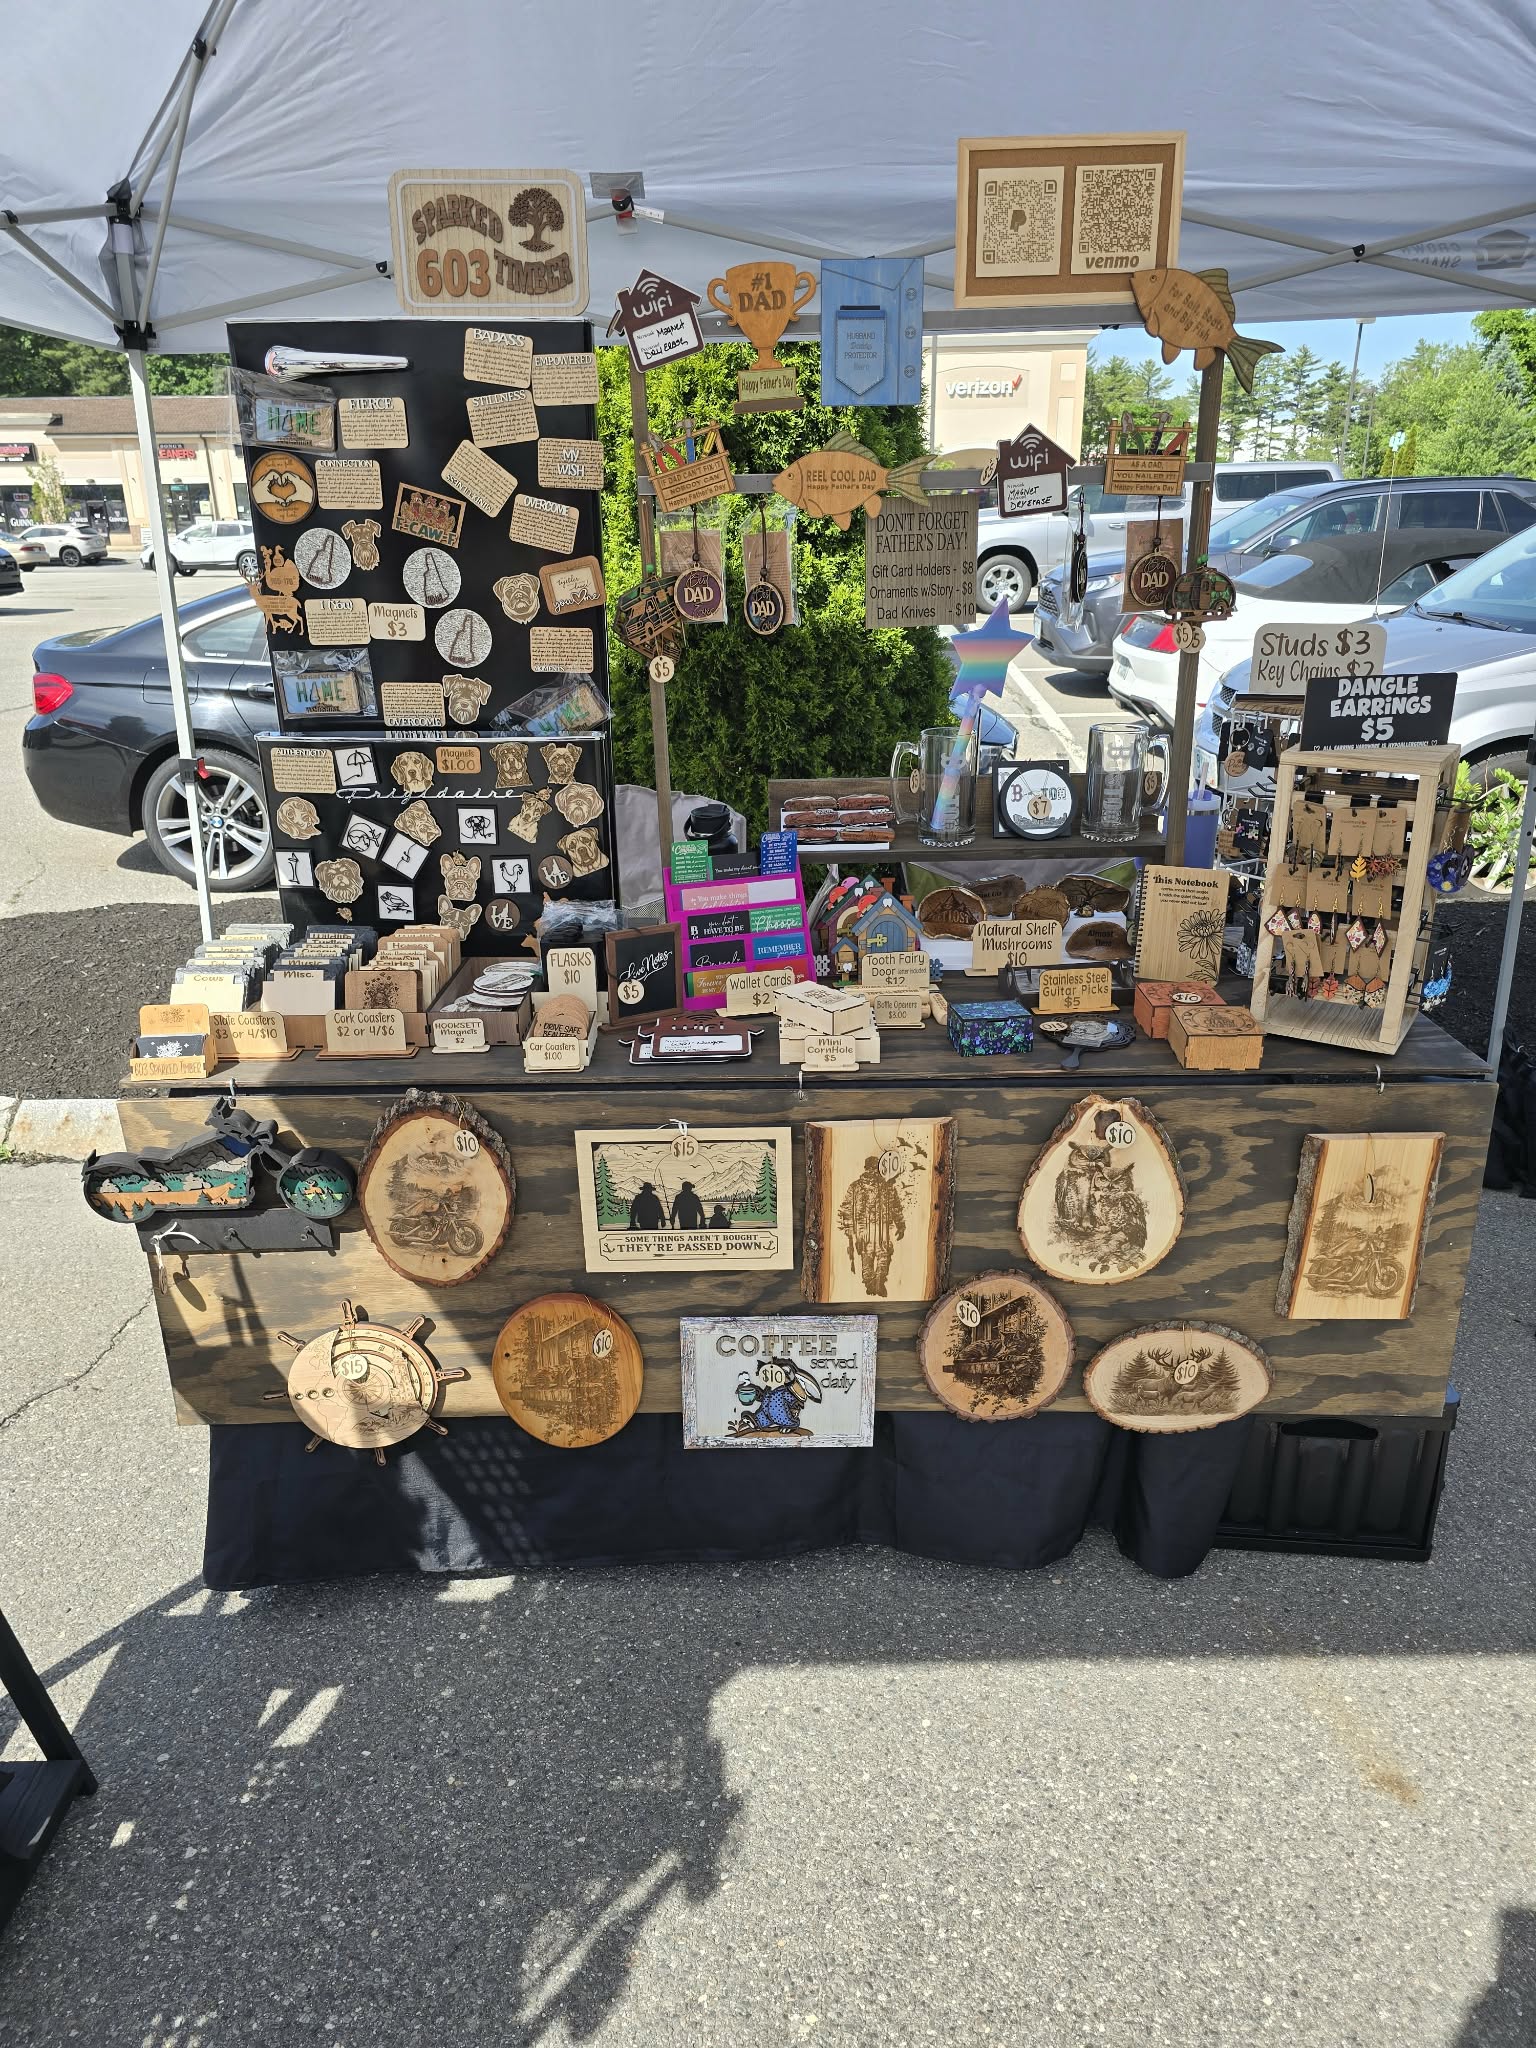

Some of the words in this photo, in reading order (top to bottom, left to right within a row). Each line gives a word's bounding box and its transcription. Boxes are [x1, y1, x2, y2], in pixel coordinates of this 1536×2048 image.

[412, 194, 504, 245] SPARKED
[1085, 254, 1140, 271] venmo
[417, 249, 492, 297] 603
[494, 248, 573, 296] TIMBER
[751, 272, 772, 291] #1
[633, 290, 672, 318] wifi
[739, 290, 787, 313] DAD
[1168, 282, 1183, 299] For
[1202, 306, 1224, 331] Boats
[1164, 303, 1181, 319] and
[1180, 310, 1194, 333] Big
[1193, 321, 1210, 342] Fish
[473, 328, 526, 348] BADASS
[534, 355, 593, 367] EMPOWERED
[844, 351, 878, 360] PROTECTOR
[741, 378, 759, 394] Happy
[760, 375, 782, 390] Father's
[782, 375, 794, 391] Day
[945, 377, 1013, 397] verizon
[349, 397, 395, 410] FIERCE
[472, 390, 527, 408] STILLNESS
[319, 460, 374, 468] CONNECTION
[1010, 448, 1049, 472] wifi
[556, 463, 586, 477] WISH
[806, 469, 828, 482] REEL
[830, 469, 857, 482] COOL
[858, 469, 877, 482] DAD
[670, 481, 701, 495] NOBODY
[704, 475, 720, 483] CAN
[806, 483, 825, 491] Happy
[826, 482, 857, 491] Father's
[858, 482, 876, 492] Day
[1114, 484, 1133, 492] Happy
[1162, 484, 1175, 492] Day
[668, 496, 688, 508] Happy
[689, 487, 713, 501] Father's
[713, 483, 726, 493] Day
[523, 495, 570, 517] OVERCOME
[876, 512, 915, 533] DON'T
[918, 511, 969, 531] FORGET
[875, 533, 934, 553] FATHER'S
[937, 532, 968, 551] DAY!
[872, 565, 889, 578] Gift
[891, 564, 913, 578] Card
[916, 562, 951, 577] Holders
[962, 561, 974, 576] $8
[1140, 572, 1170, 589] DAD
[684, 586, 714, 603] DAD
[869, 585, 919, 599] Ornaments
[961, 581, 973, 596] $8
[374, 605, 418, 620] Magnets
[751, 600, 776, 617] DAD
[877, 606, 898, 620] Dad
[901, 605, 936, 619] Knives
[955, 602, 975, 617] $10
[388, 620, 407, 637] $3
[1176, 626, 1189, 643] $5
[1260, 633, 1329, 657] Studs
[1335, 628, 1371, 656] $3
[653, 660, 671, 678] $5
[1257, 659, 1285, 688] Key
[1290, 660, 1341, 681] Chains
[1337, 675, 1419, 698] DANGLE
[389, 717, 442, 727] OVERCOME
[1361, 717, 1395, 742] $5
[275, 748, 327, 758] AUTHENTICITY
[438, 749, 475, 760] Magnets
[441, 760, 477, 772] $1.00
[336, 787, 523, 804] Frigidaire
[1033, 800, 1048, 815] $7
[1153, 874, 1173, 885] This
[1175, 877, 1219, 889] Notebook
[728, 892, 748, 901] things
[704, 926, 721, 935] HAVE
[720, 926, 732, 934] TO
[977, 924, 1022, 937] Natural
[1026, 921, 1057, 936] Shelf
[757, 943, 802, 955] REMEMBER
[981, 937, 1053, 951] Mushrooms
[550, 951, 592, 967] FLASKS
[867, 955, 896, 966] Tooth
[898, 953, 925, 967] Fairy
[1007, 951, 1028, 966] $10
[564, 969, 581, 985] $10
[729, 978, 761, 990] Wallet
[763, 973, 792, 987] Cards
[1042, 974, 1084, 986] Stainless
[1085, 973, 1109, 985] Steel
[623, 985, 639, 1000] $5
[1042, 986, 1077, 997] Guitar
[1081, 984, 1109, 995] Picks
[752, 992, 771, 1007] $2
[876, 1001, 893, 1009] Bottle
[894, 1001, 918, 1011] Openers
[1063, 996, 1081, 1008] $5
[213, 1014, 236, 1026] Slate
[237, 1014, 276, 1026] Coasters
[334, 1012, 355, 1024] Cork
[357, 1012, 395, 1024] Coasters
[888, 1010, 907, 1019] $3.00
[215, 1028, 229, 1040] $3
[232, 1030, 244, 1039] or
[247, 1028, 278, 1040] 4/$10
[336, 1026, 350, 1038] $2
[353, 1028, 365, 1037] or
[369, 1025, 395, 1037] 4/$6
[434, 1022, 482, 1030] HOOKSETT
[440, 1028, 478, 1037] Magnets
[543, 1022, 563, 1031] DRIVE
[563, 1025, 582, 1035] SAFE
[529, 1042, 544, 1051] Car
[545, 1042, 576, 1051] Coasters
[807, 1046, 853, 1055] CornHole
[818, 1038, 842, 1047] Mini
[543, 1052, 562, 1060] $1.00
[824, 1054, 837, 1063] $5
[134, 1063, 149, 1076] 603
[149, 1061, 179, 1075] SPARKED
[179, 1060, 202, 1074] TIMBER
[1108, 1125, 1133, 1146] $10
[456, 1135, 477, 1153] $10
[672, 1138, 695, 1157] $15
[880, 1157, 900, 1175] $10
[624, 1235, 650, 1244] SOME
[652, 1235, 686, 1243] THINGS
[688, 1234, 721, 1242] AREN'T
[722, 1233, 759, 1242] BOUGHT
[616, 1243, 674, 1254] THEY'RE
[677, 1242, 723, 1252] PASSED
[726, 1241, 762, 1250] DOWN
[959, 1303, 978, 1324] $10
[593, 1336, 612, 1354] $10
[715, 1334, 838, 1358] COFFEE
[341, 1359, 364, 1376] $15
[810, 1353, 858, 1371] served
[761, 1368, 784, 1385] $10
[1176, 1364, 1197, 1382] $10
[820, 1371, 857, 1395] daily
